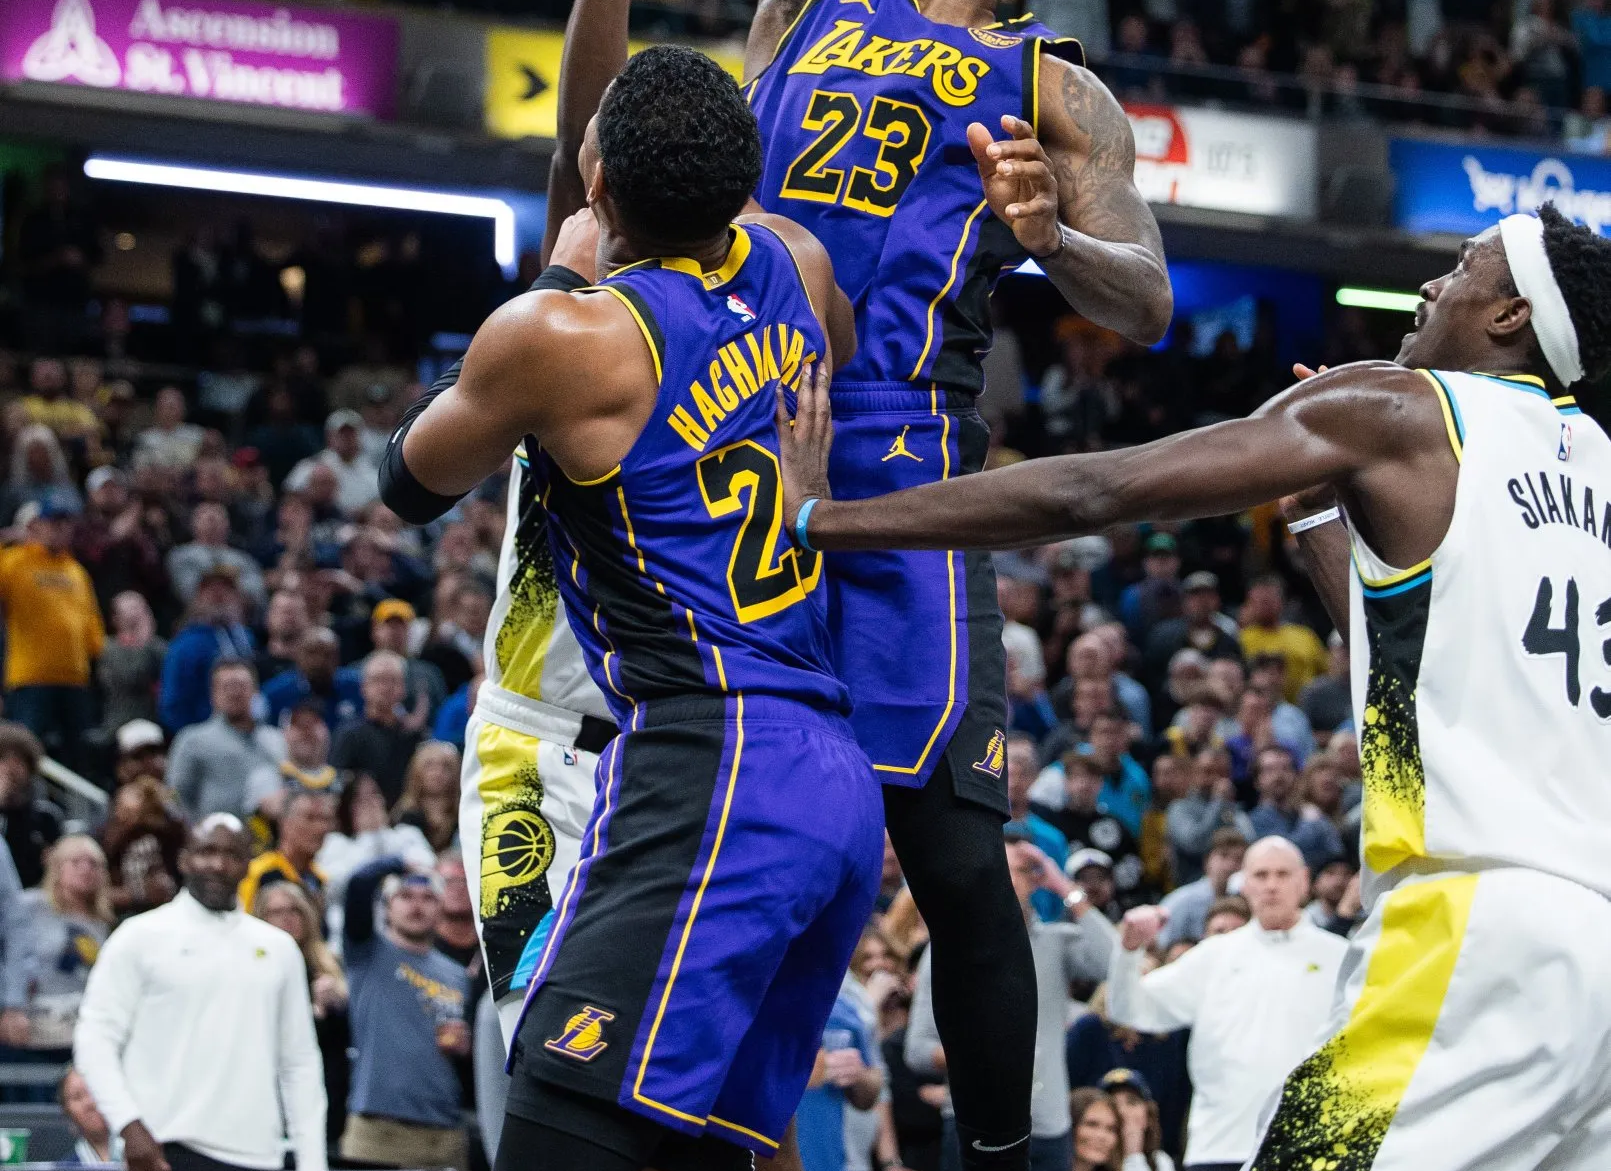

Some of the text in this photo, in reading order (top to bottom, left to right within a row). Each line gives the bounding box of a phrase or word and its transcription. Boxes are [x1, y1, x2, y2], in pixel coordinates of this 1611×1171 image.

[183, 46, 344, 111] Vincent
[787, 19, 992, 108] LAKERS
[779, 88, 932, 218] 23
